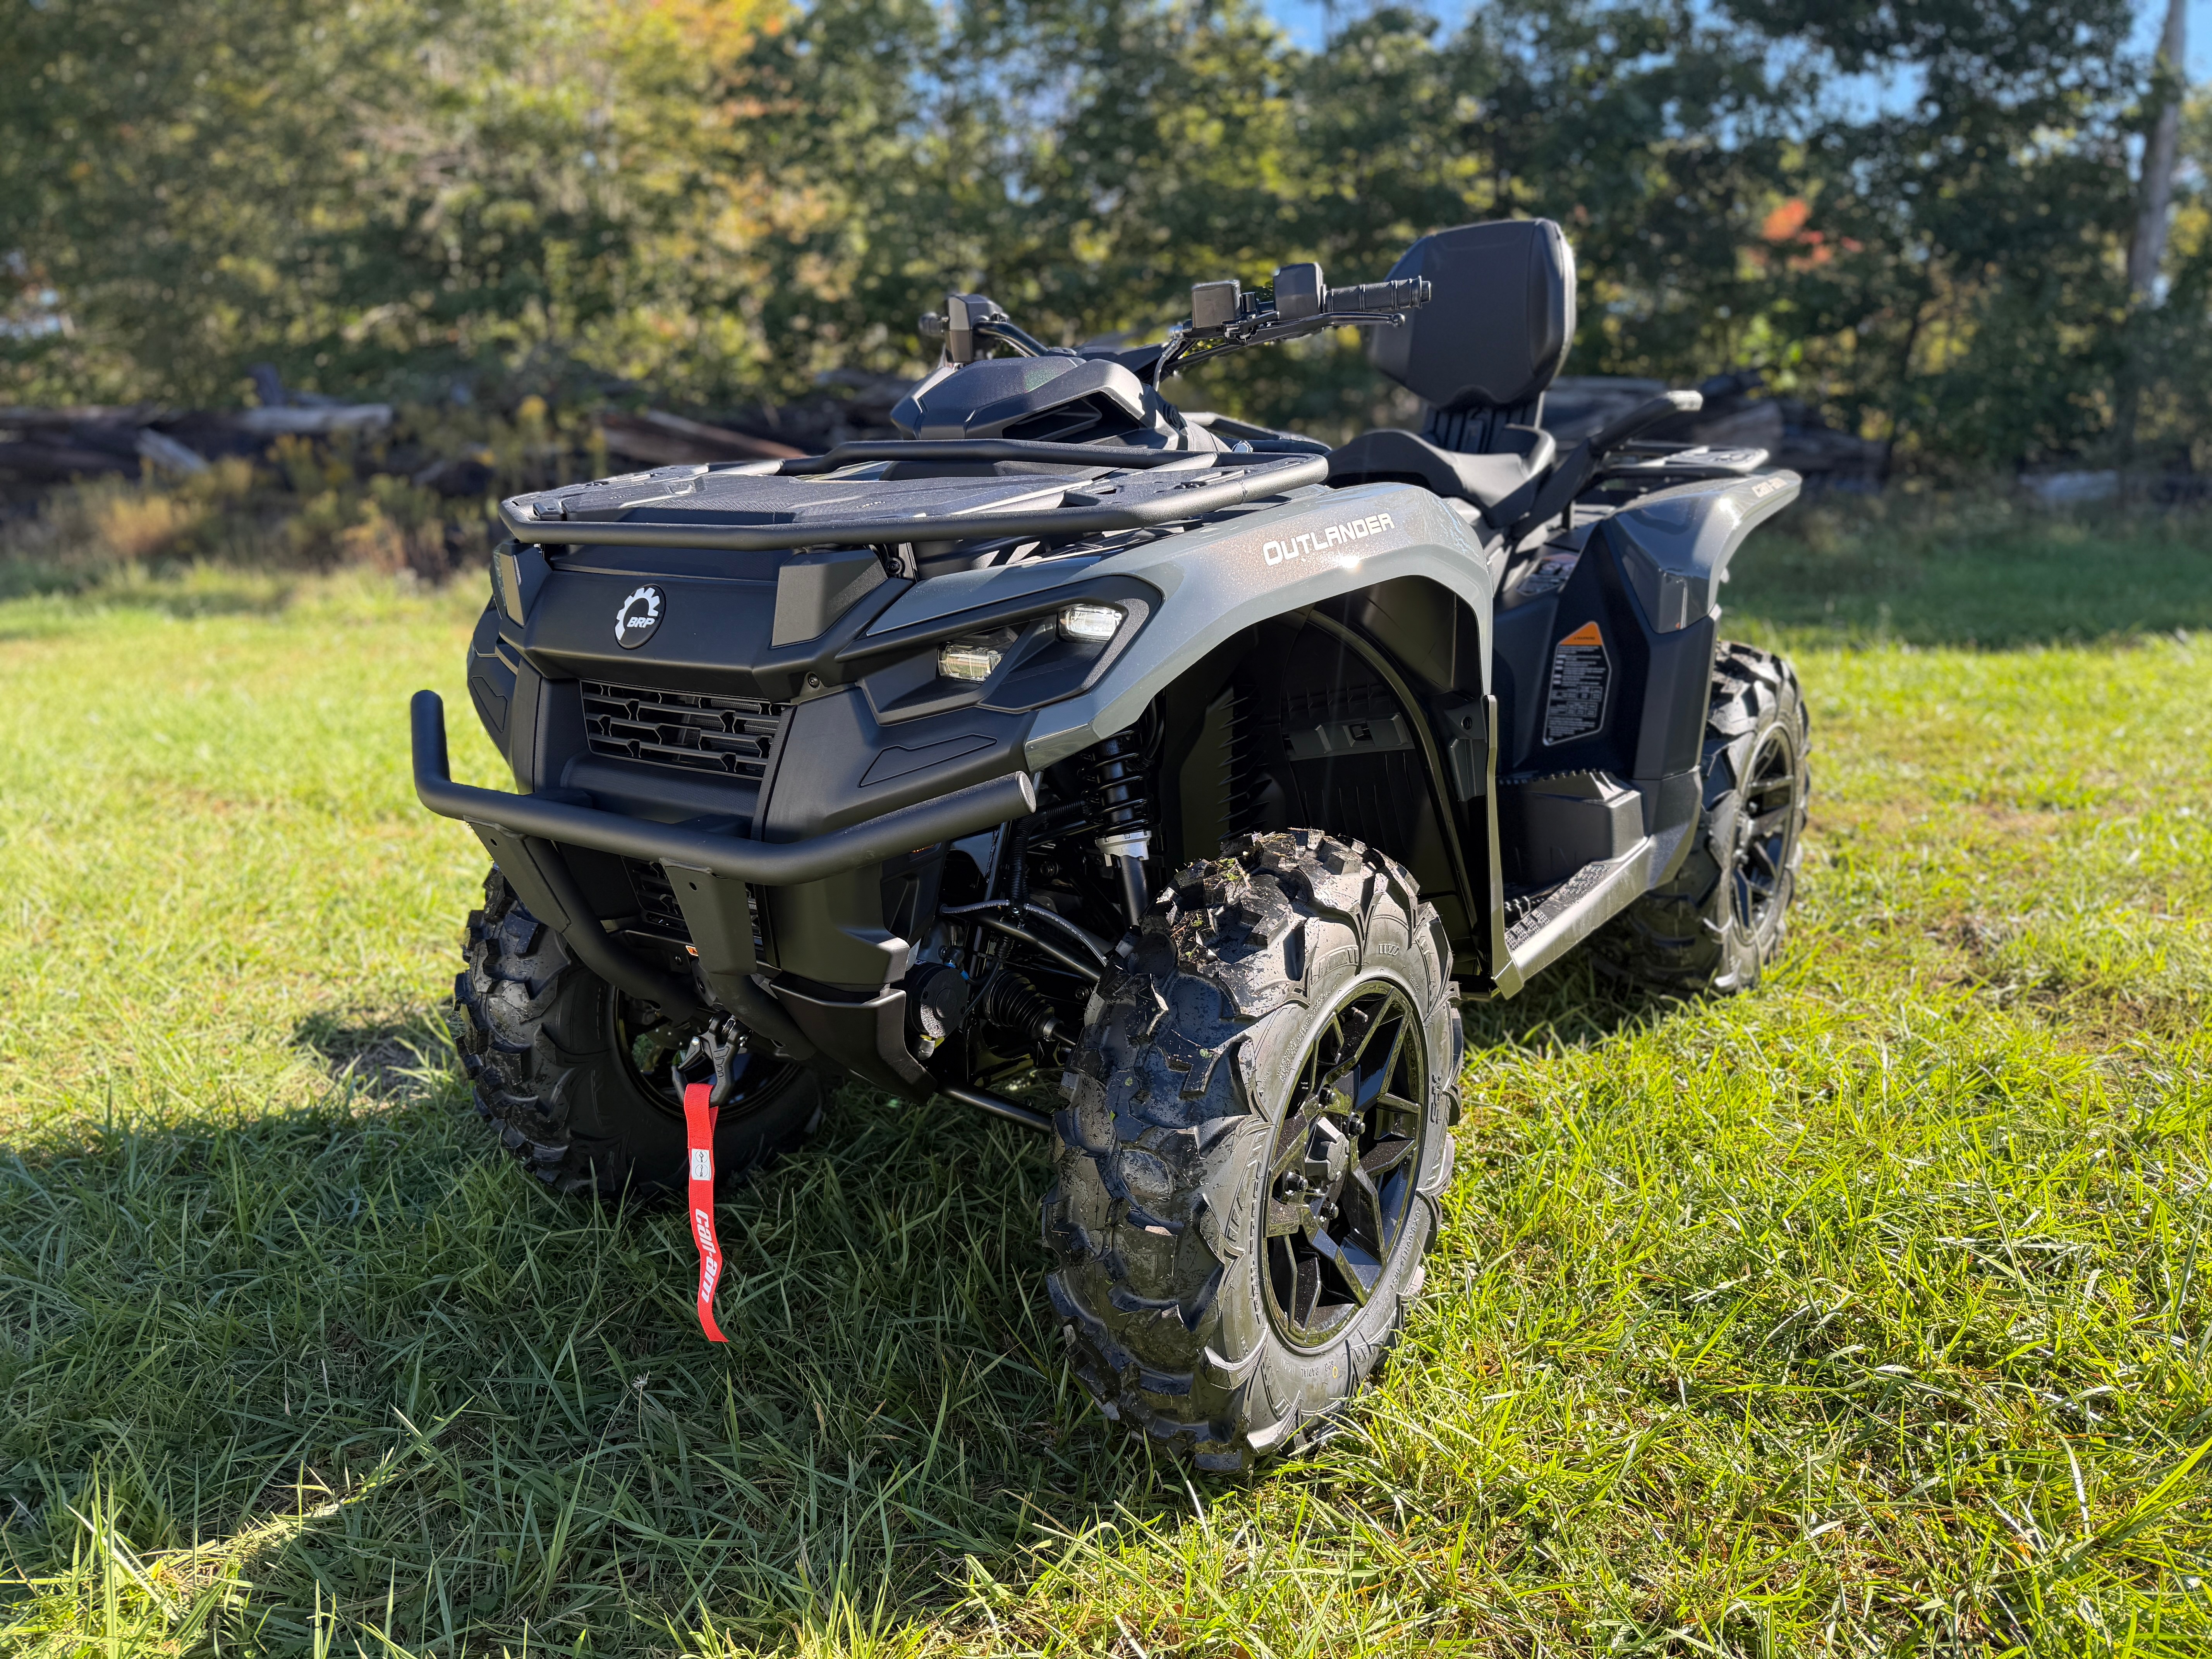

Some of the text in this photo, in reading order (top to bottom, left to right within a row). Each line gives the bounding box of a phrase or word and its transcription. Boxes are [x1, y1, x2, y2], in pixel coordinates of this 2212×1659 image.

[1262, 512, 1395, 566] OUTLANDER
[627, 617, 655, 628] BRP
[695, 1208, 718, 1303] can-am
[1300, 1367, 1319, 1377] RADIAL
